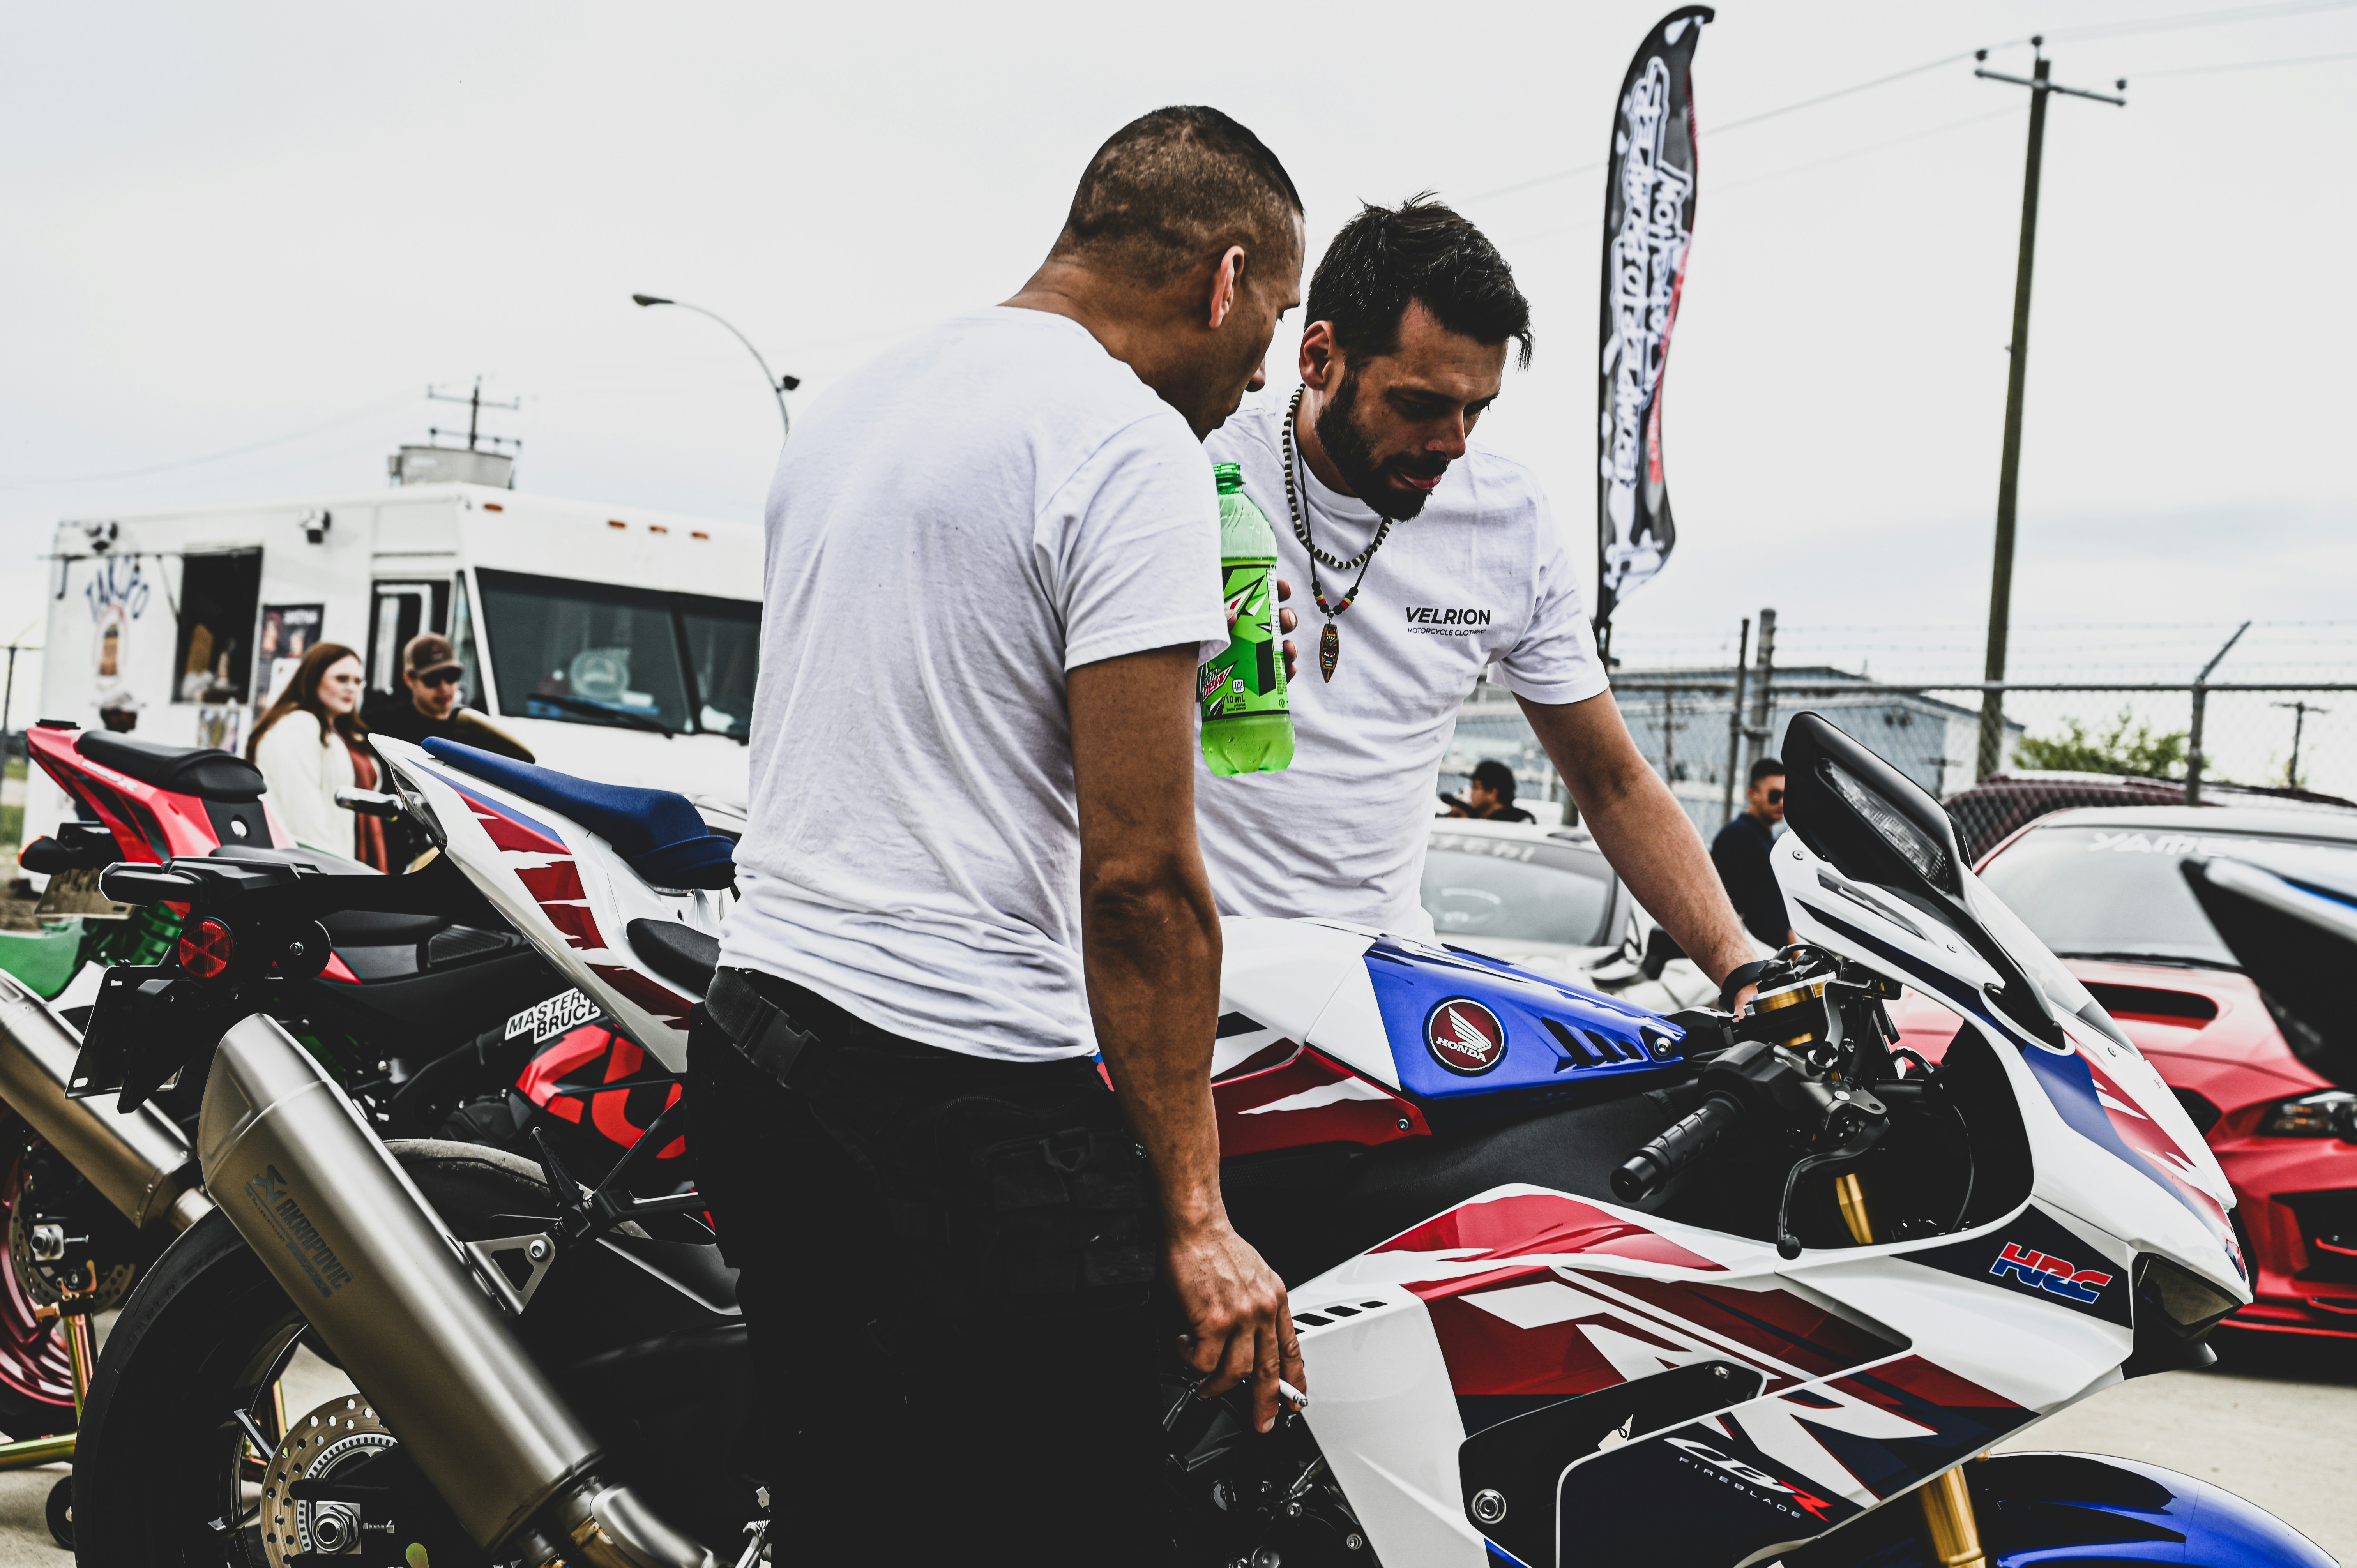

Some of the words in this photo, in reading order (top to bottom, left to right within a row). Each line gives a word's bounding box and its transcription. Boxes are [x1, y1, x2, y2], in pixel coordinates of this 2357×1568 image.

[1406, 607, 1490, 625] VELRION
[1408, 627, 1453, 636] MOTORCYCLE
[1235, 694, 1245, 703] mL
[536, 1000, 597, 1038] BRUCE
[1436, 1037, 1487, 1063] HONDA
[1989, 1241, 2113, 1304] HRC
[1679, 1457, 1801, 1519] FIREBLADE
